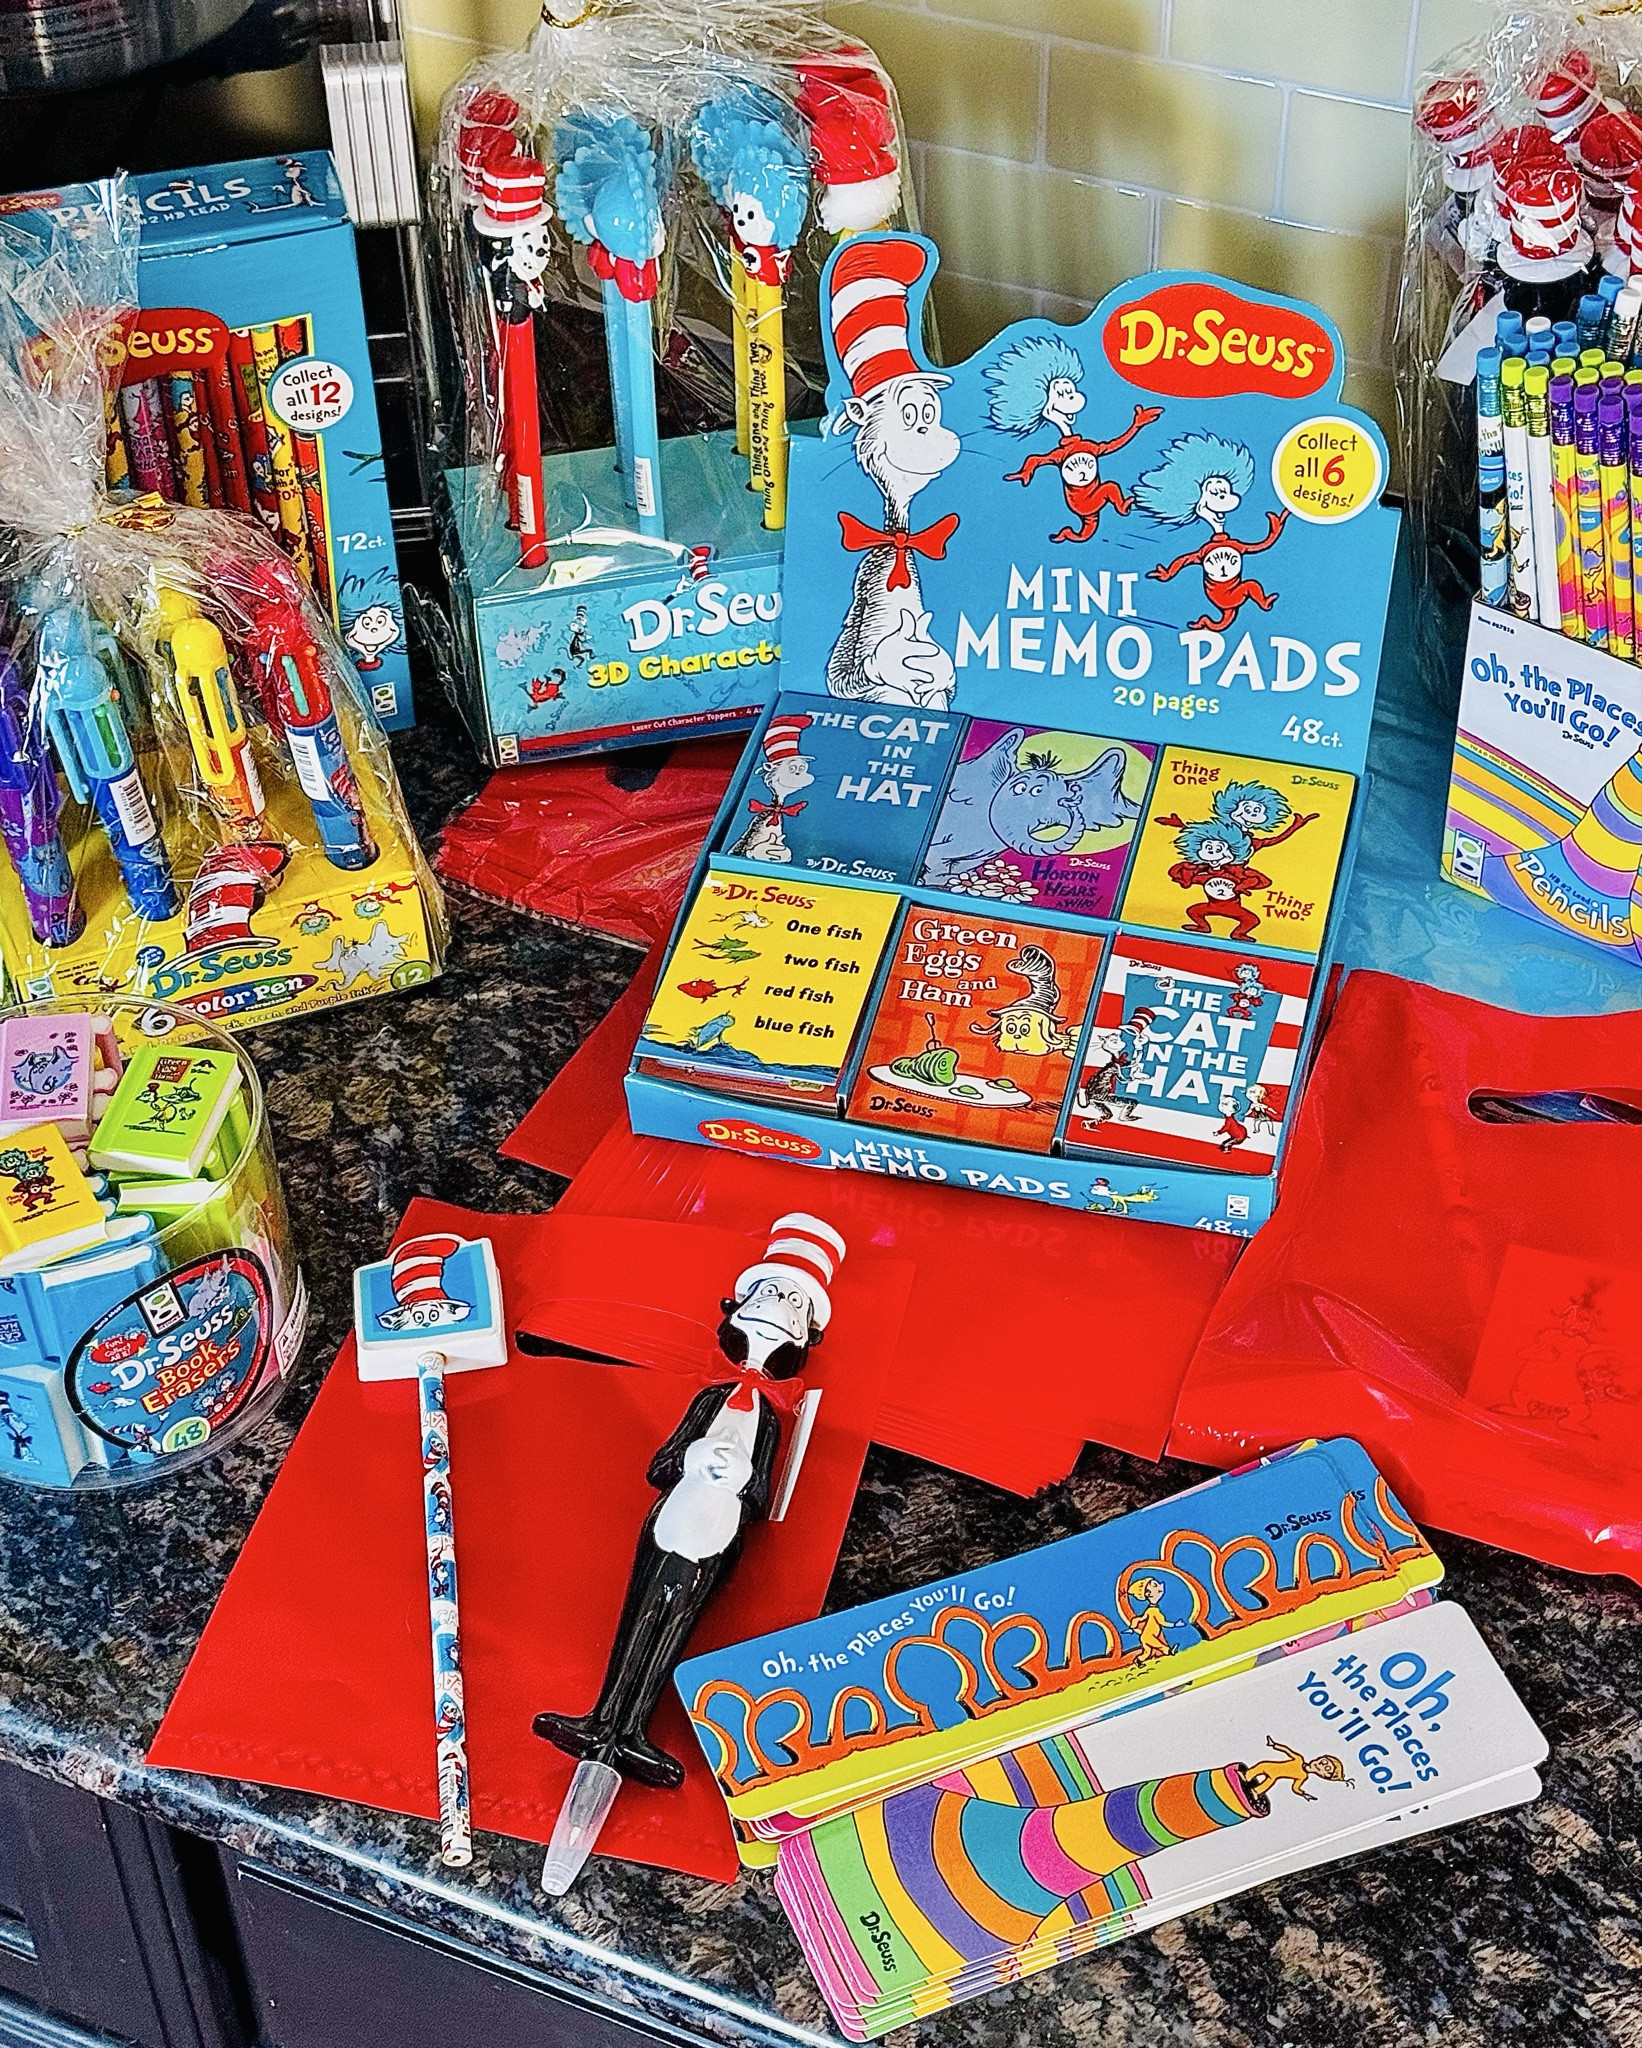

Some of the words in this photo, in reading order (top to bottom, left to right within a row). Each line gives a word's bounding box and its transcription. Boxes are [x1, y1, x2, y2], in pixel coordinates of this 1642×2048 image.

[191, 203, 231, 217] LEAD
[283, 365, 334, 387] Collect
[750, 368, 761, 398] Thing
[286, 389, 308, 407] all
[310, 381, 342, 406] 12
[290, 406, 342, 423] designs!
[753, 402, 761, 421] and
[762, 402, 775, 430] Thing
[753, 423, 762, 445] One
[1297, 433, 1358, 452] Collect
[752, 447, 762, 477] Thing
[763, 456, 771, 477] One
[1064, 457, 1095, 473] THING
[1294, 457, 1319, 479] all
[1322, 455, 1346, 488] 6
[1078, 471, 1089, 482] 2
[765, 480, 775, 511] Thing
[1293, 484, 1354, 509] designs!
[336, 532, 387, 554] 72ct.
[1205, 551, 1238, 566] THING
[1219, 565, 1229, 577] 1
[1006, 563, 1139, 618] MINI
[622, 582, 782, 653] Dr.Seu
[954, 611, 1153, 681] MEMO
[1179, 628, 1362, 698] PADS
[588, 661, 631, 689] 3D
[1112, 686, 1146, 706] 20
[1152, 691, 1220, 720] pages
[1470, 653, 1516, 689] Oh,
[1520, 664, 1562, 698] the
[1566, 677, 1642, 738] Places
[631, 722, 652, 732] Laser
[667, 715, 705, 727] Character
[705, 710, 737, 724] Toppers
[805, 711, 858, 730] THE
[858, 714, 950, 745] CAT
[1281, 715, 1343, 749] 48ct.
[1504, 692, 1566, 724] You'll
[1569, 710, 1621, 749] Go!
[881, 744, 913, 760] IN
[867, 760, 916, 778] THE
[1170, 760, 1222, 782] Thing
[1173, 774, 1208, 786] One
[835, 775, 932, 808] HAT
[806, 858, 821, 869] By
[1031, 858, 1101, 883] HORTON
[712, 885, 729, 897] By
[1043, 881, 1098, 897] HEARS
[1206, 879, 1234, 890] THING
[1217, 889, 1227, 897] 2
[1514, 852, 1630, 938] Pencils
[1262, 904, 1306, 922] Two.
[1266, 890, 1315, 917] Thing
[786, 920, 822, 935] One
[826, 924, 863, 941] fish
[913, 918, 1018, 950] Green
[784, 953, 819, 969] two
[824, 957, 861, 974] fish
[901, 942, 983, 978] Eggs
[399, 968, 424, 986] 12
[957, 976, 999, 991] and
[140, 1006, 176, 1037] 6
[255, 975, 308, 1000] Pen
[285, 1002, 308, 1015] and
[309, 993, 348, 1011] Purple
[764, 985, 796, 998] red
[798, 987, 835, 1005] fish
[898, 979, 974, 1008] Ham
[1163, 986, 1224, 1013] THE
[754, 1015, 794, 1033] blue
[798, 1021, 835, 1039] fish
[1146, 1006, 1256, 1053] CAT
[1146, 1043, 1174, 1063] N
[1181, 1048, 1249, 1075] THE
[1124, 1063, 1247, 1104] HAT
[854, 1138, 930, 1163] MINI
[829, 1148, 948, 1182] MEMO
[960, 1168, 1072, 1199] PADS
[141, 1339, 241, 1414] Erasers
[156, 1341, 218, 1388] Book
[172, 1421, 204, 1448] 48
[761, 1650, 804, 1679] Oh,
[808, 1653, 850, 1673] the
[846, 1611, 915, 1657] Places
[909, 1585, 966, 1613] You'll
[973, 1586, 1017, 1611] Go!
[1379, 1651, 1457, 1733] Oh,
[1331, 1654, 1378, 1702] the
[1371, 1697, 1440, 1782] Places
[1296, 1670, 1371, 1743] You'll
[1358, 1743, 1413, 1795] Go!
